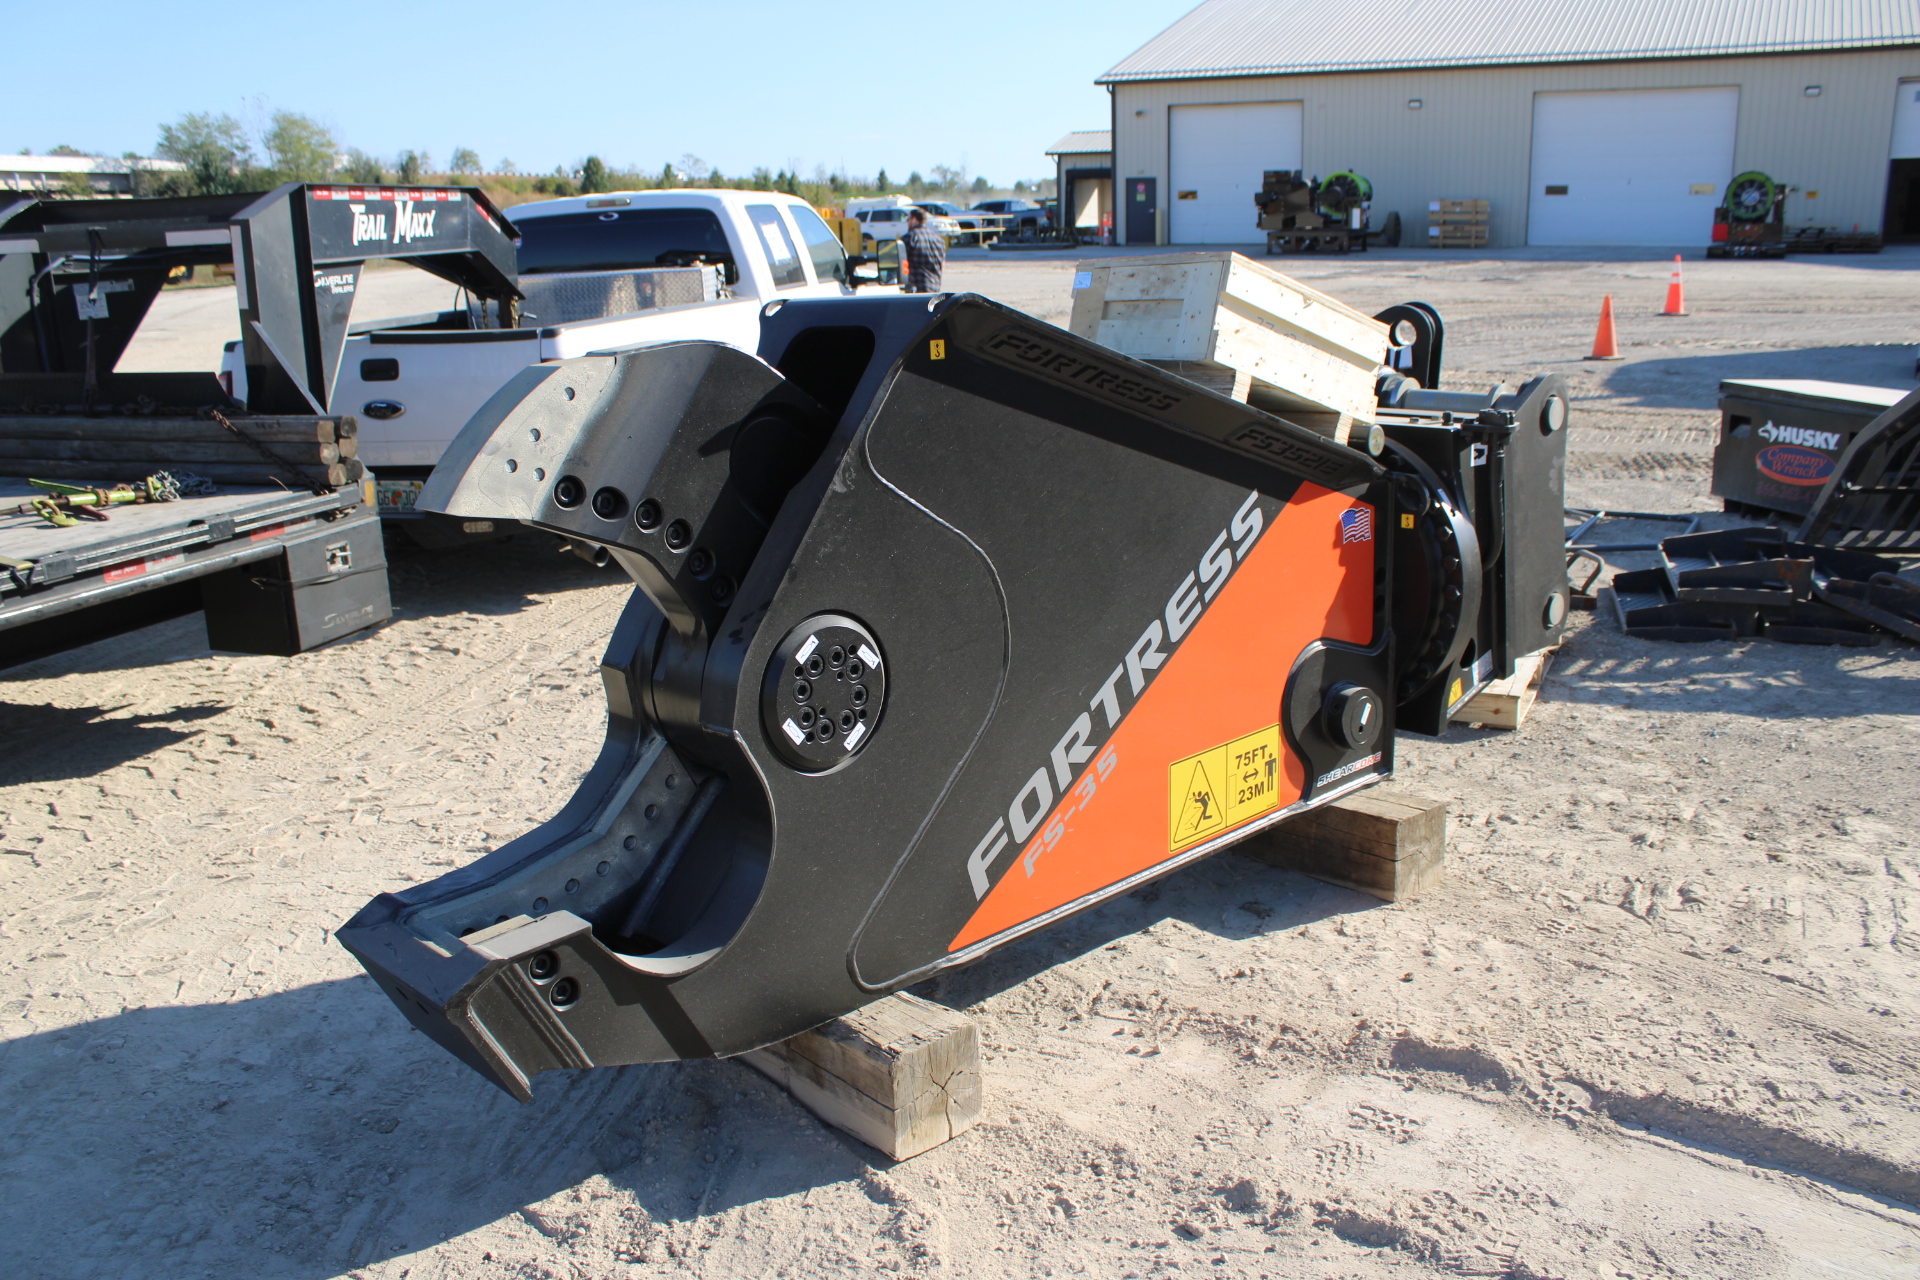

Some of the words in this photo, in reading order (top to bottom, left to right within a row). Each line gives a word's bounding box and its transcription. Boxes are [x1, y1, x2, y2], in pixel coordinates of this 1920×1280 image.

[349, 204, 387, 246] TRAIL
[393, 200, 436, 244] MAXX
[990, 333, 1182, 412] FORTRESS
[1777, 425, 1841, 451] HUSKY
[1767, 447, 1827, 470] Company
[1772, 460, 1818, 477] Wrench
[966, 488, 1264, 902] FORTRESS
[1317, 751, 1382, 787] SHEARCORE
[1238, 780, 1265, 805] 23M
[1023, 744, 1118, 880] FS-35
